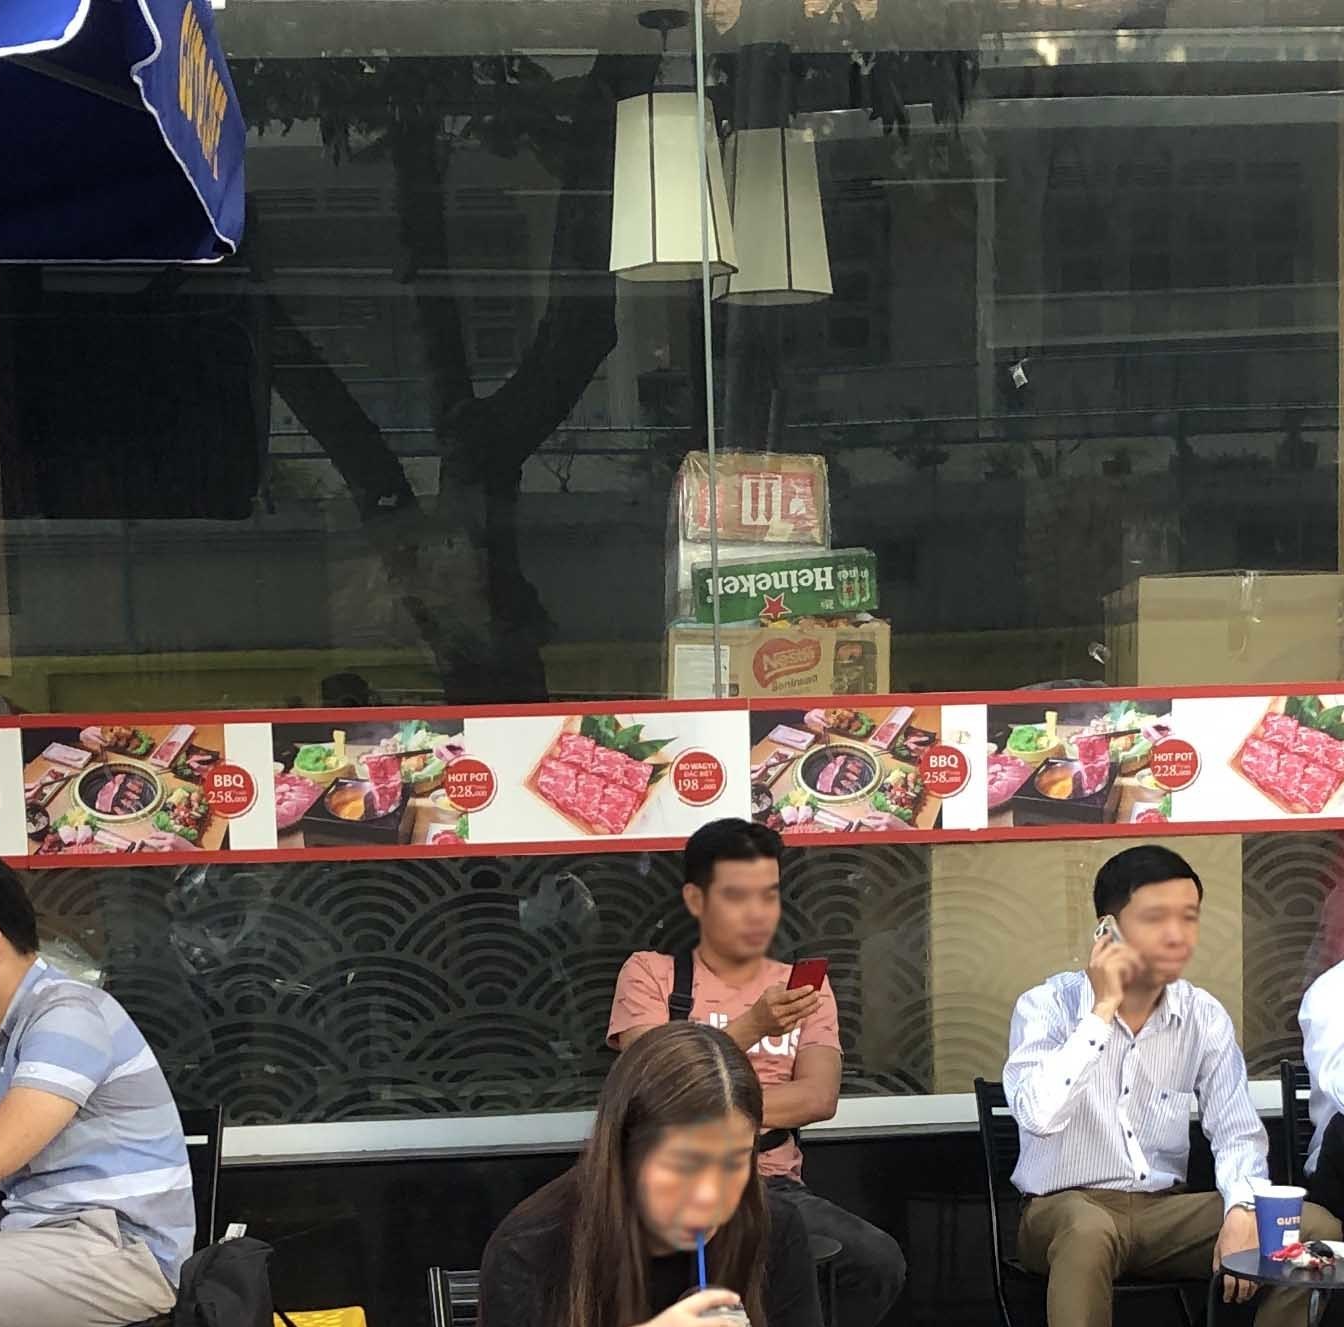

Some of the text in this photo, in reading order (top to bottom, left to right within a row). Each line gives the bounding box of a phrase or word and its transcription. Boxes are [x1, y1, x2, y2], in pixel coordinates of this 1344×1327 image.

[705, 566, 835, 603] Heineken
[929, 755, 958, 768] BBQ
[1154, 752, 1193, 761] HOT POT
[213, 774, 244, 788] BBQ
[448, 772, 488, 782] HOT POT
